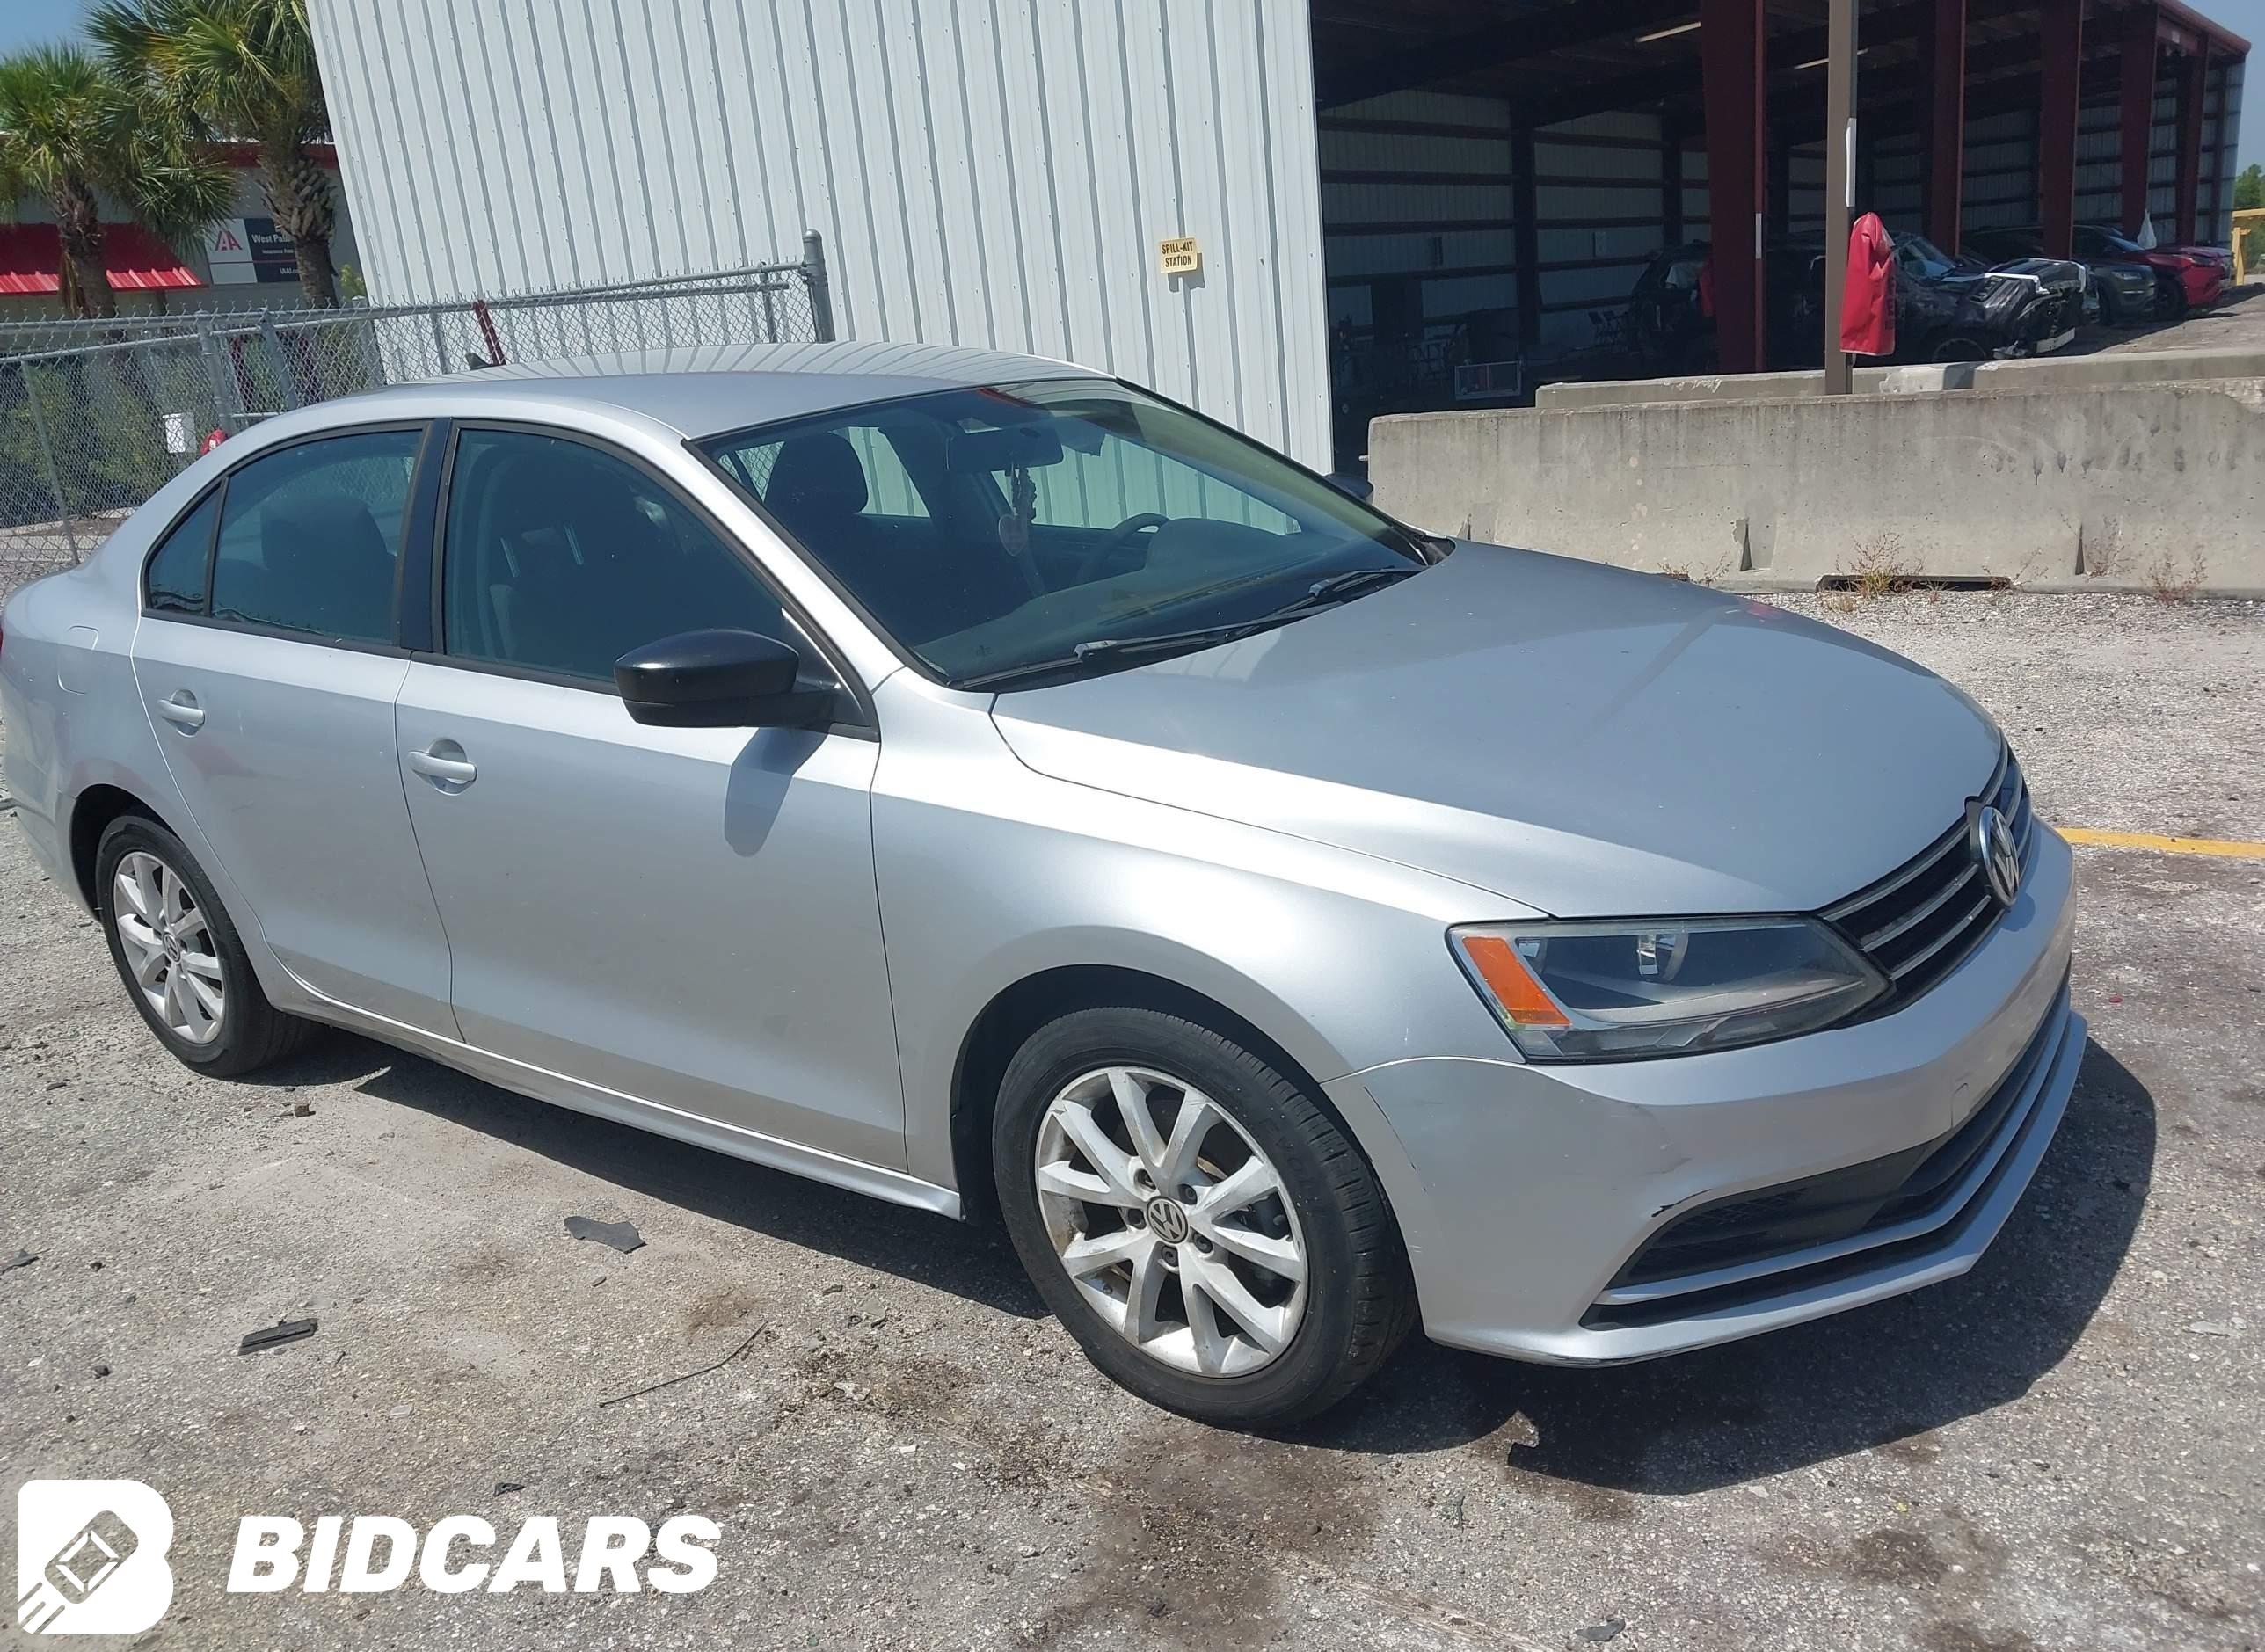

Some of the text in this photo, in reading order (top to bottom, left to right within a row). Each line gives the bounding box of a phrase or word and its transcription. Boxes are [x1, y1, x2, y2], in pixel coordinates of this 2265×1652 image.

[251, 234, 273, 244] West
[1162, 241, 1193, 255] SPILL-KIT
[1165, 255, 1192, 268] STATION
[1147, 1197, 1187, 1242] VW
